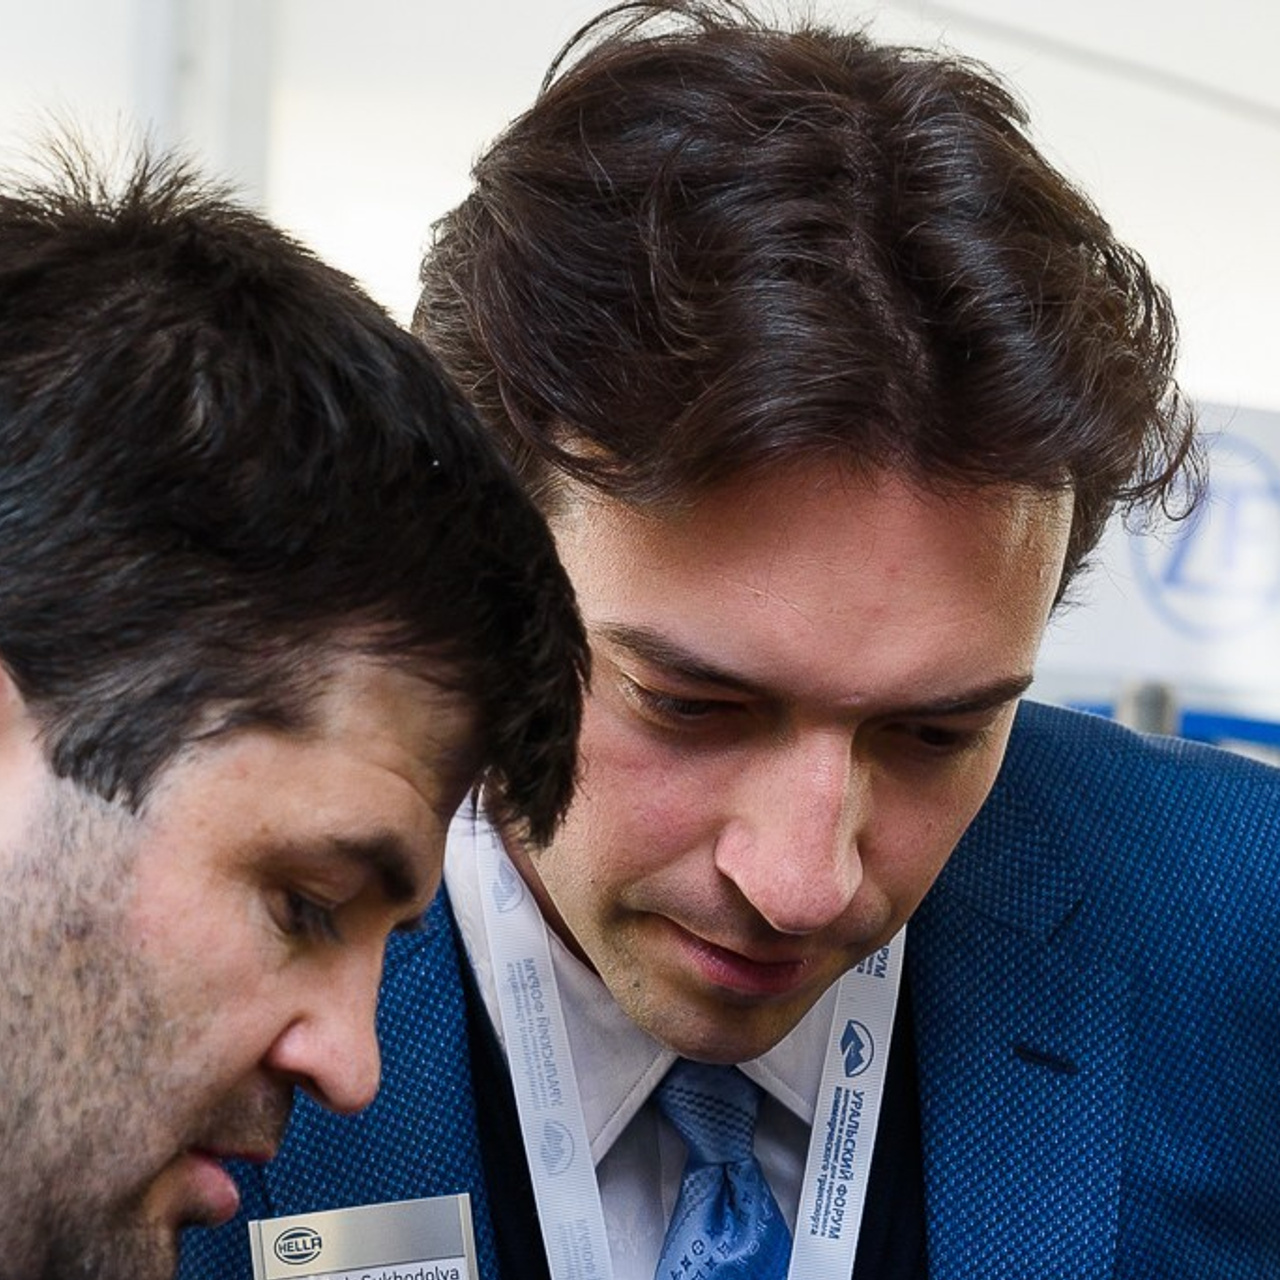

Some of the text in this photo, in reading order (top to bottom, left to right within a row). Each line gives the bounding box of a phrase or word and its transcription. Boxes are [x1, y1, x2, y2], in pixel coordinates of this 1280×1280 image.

[873, 948, 889, 979] РУМ
[828, 1089, 865, 1240] УРАЛЬСКИЙ ФОРУМ
[277, 1236, 323, 1254] HELLA
